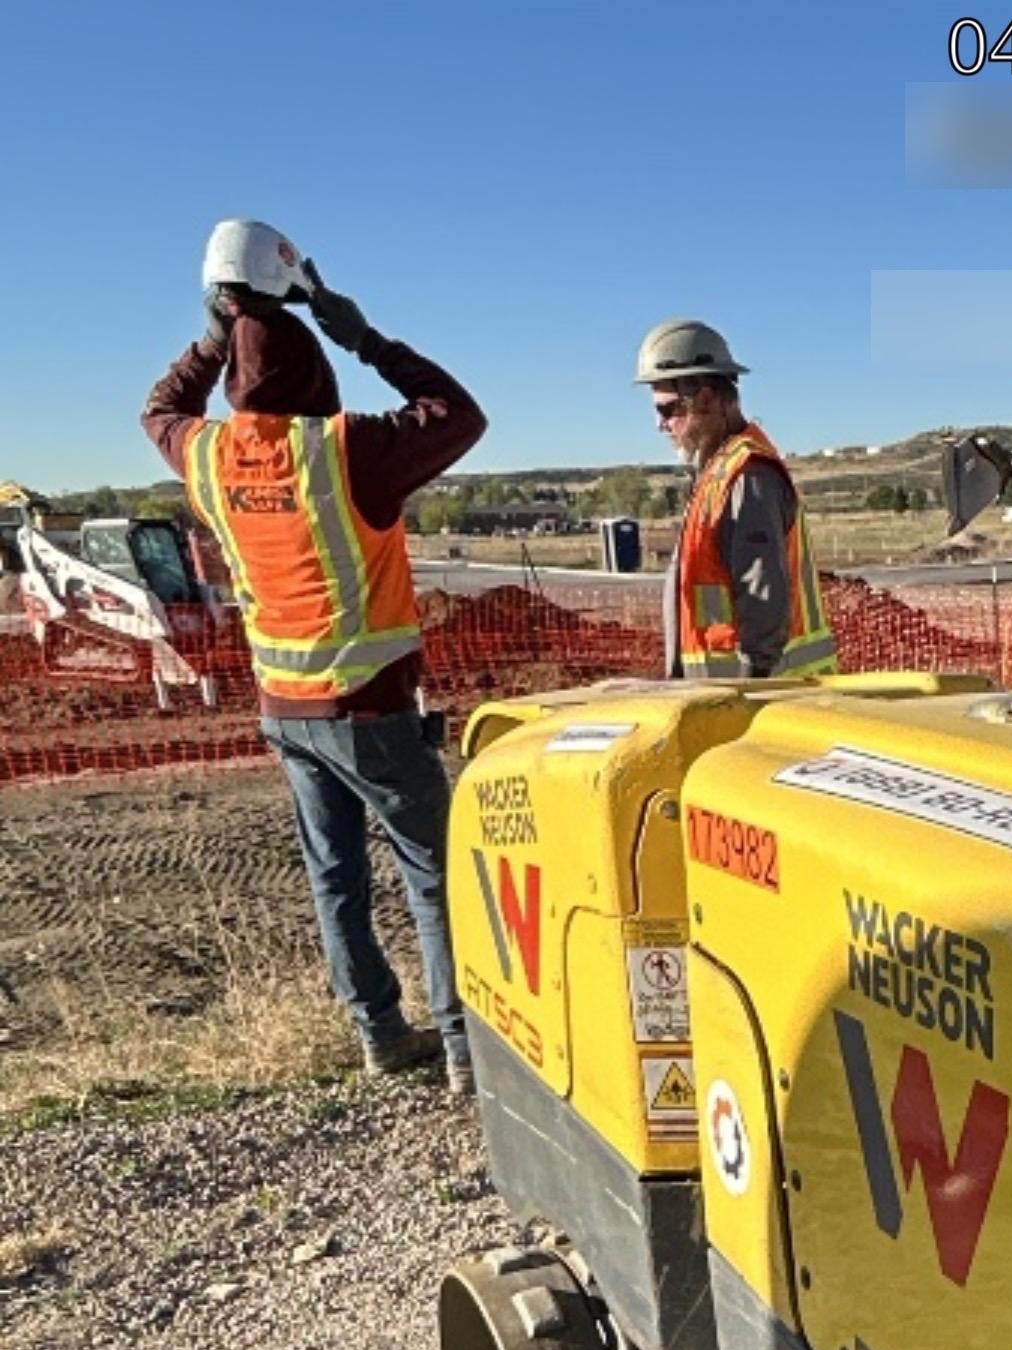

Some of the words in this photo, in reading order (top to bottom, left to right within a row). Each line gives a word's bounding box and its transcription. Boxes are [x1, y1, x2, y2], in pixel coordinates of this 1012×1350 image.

[473, 773, 531, 811] WACKER
[479, 811, 538, 846] NEUSON
[688, 808, 779, 890] 173982
[843, 888, 993, 1003] WACKER
[848, 943, 994, 1061] NEUSON
